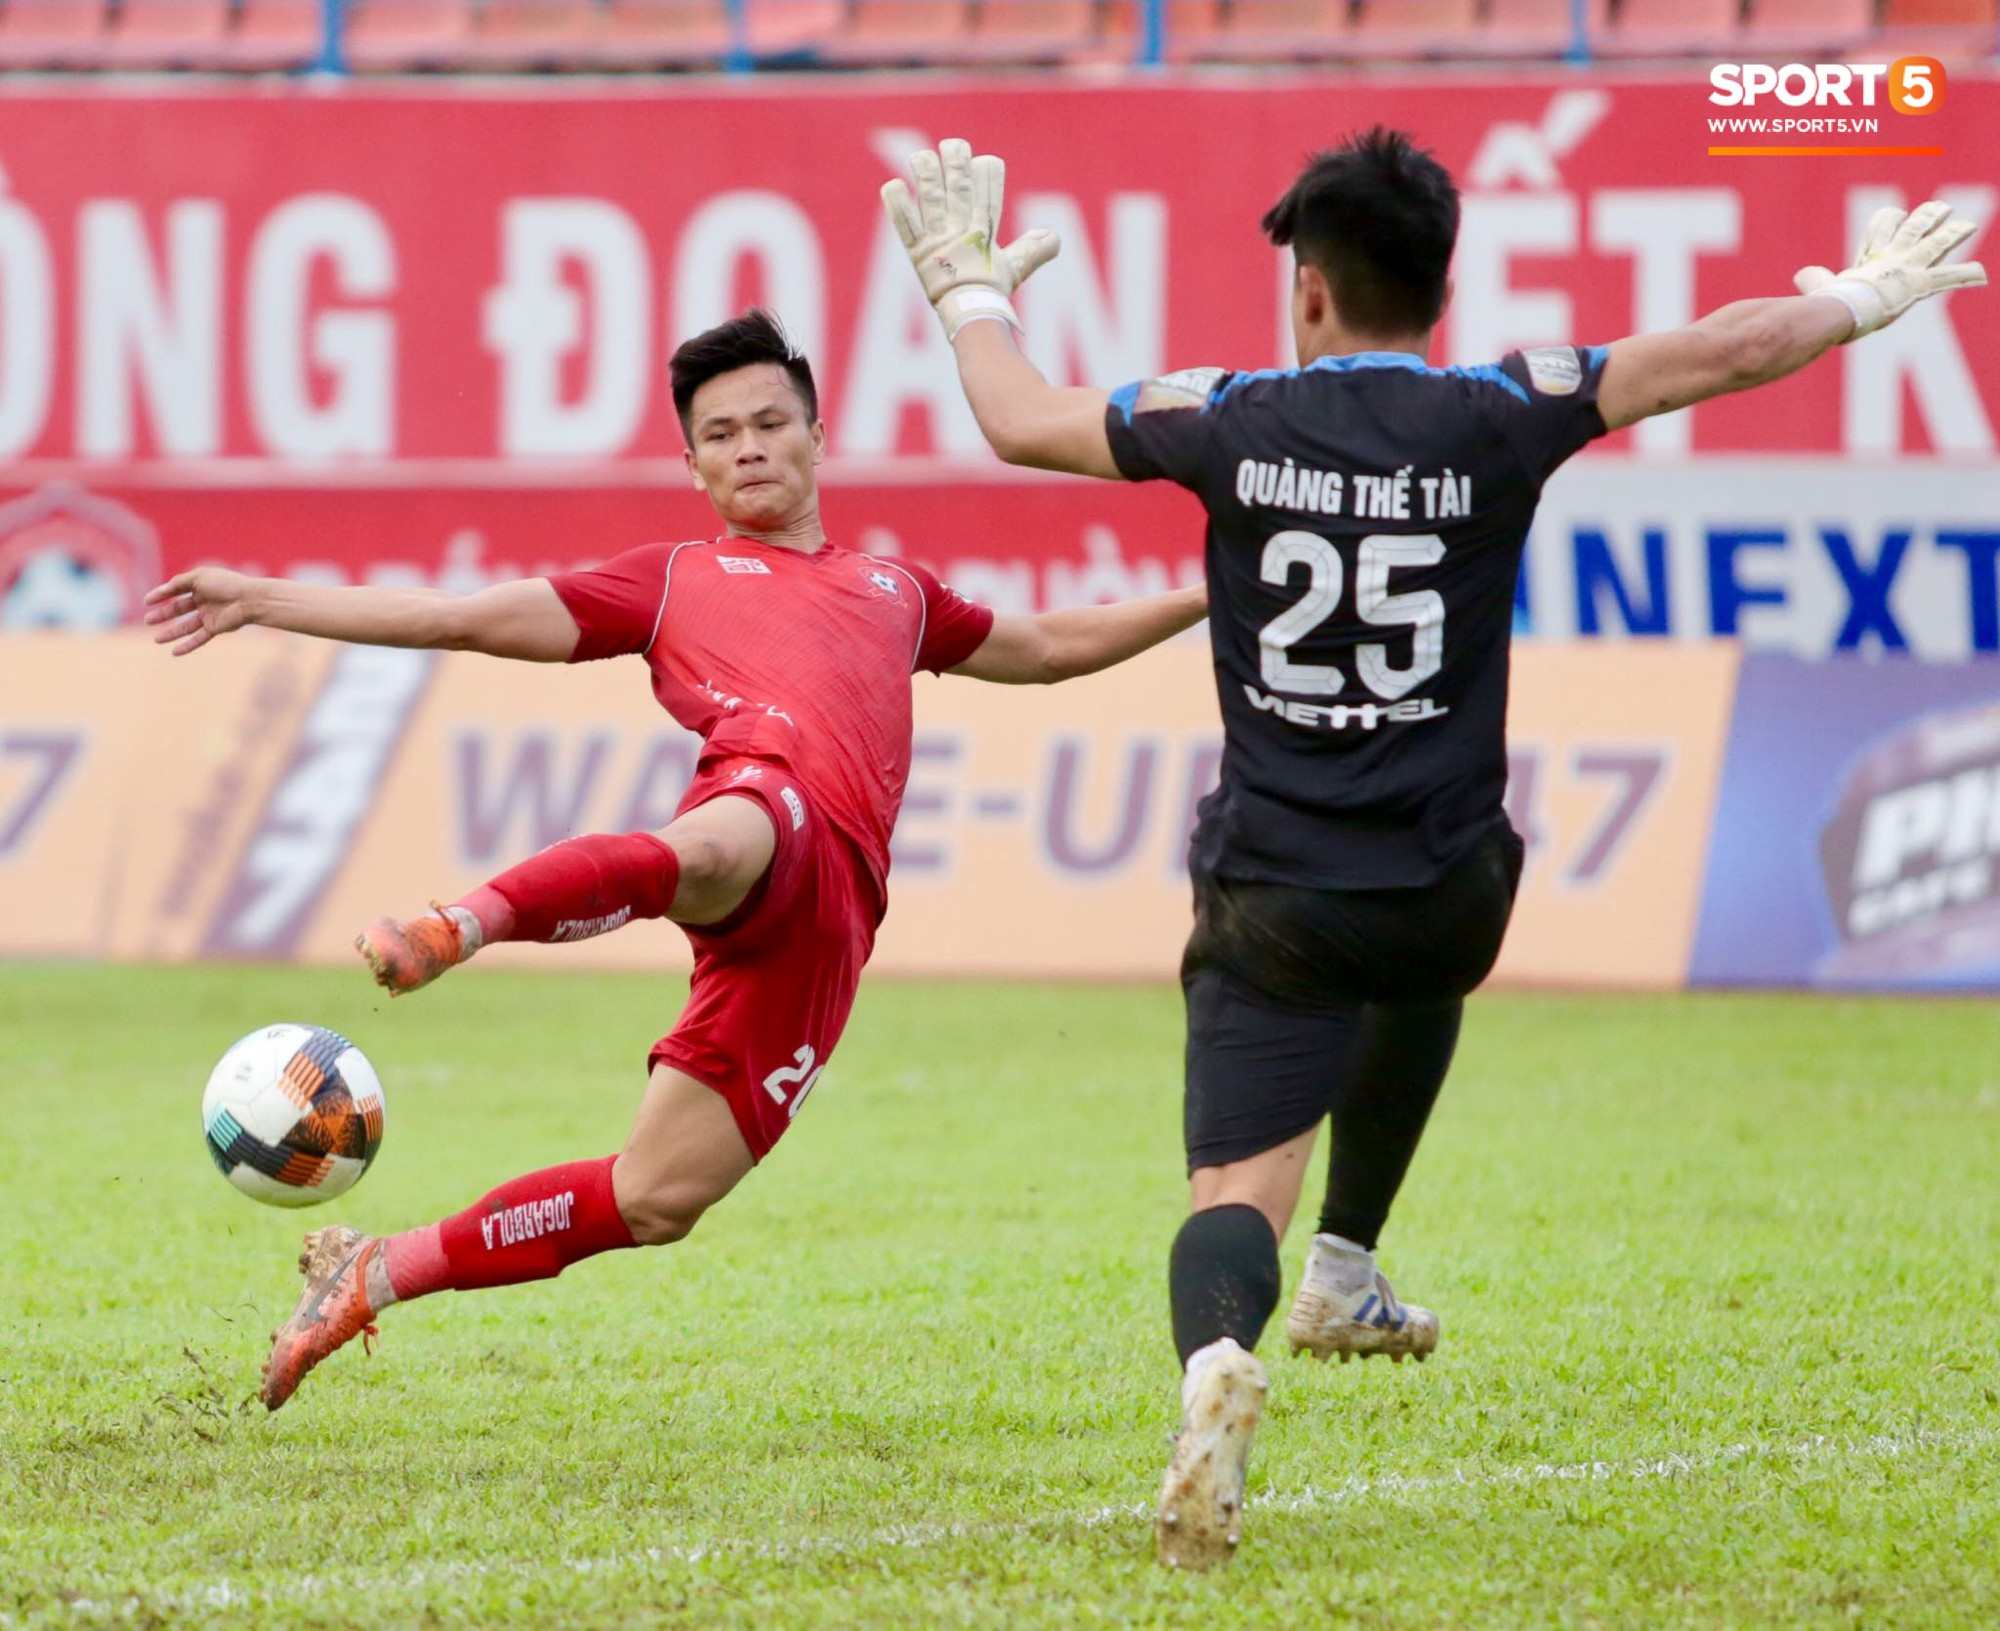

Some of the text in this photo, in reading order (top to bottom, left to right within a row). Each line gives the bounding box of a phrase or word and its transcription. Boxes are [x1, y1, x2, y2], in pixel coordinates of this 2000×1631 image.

[1277, 90, 1742, 458] ẾT
[1236, 457, 1472, 520] QUÀNG THẾ TÀI
[1258, 530, 1447, 700] 25
[1511, 525, 2000, 652] NEXT
[1243, 684, 1449, 730] VIETTEL
[481, 1190, 575, 1251] JOGARBOLA
